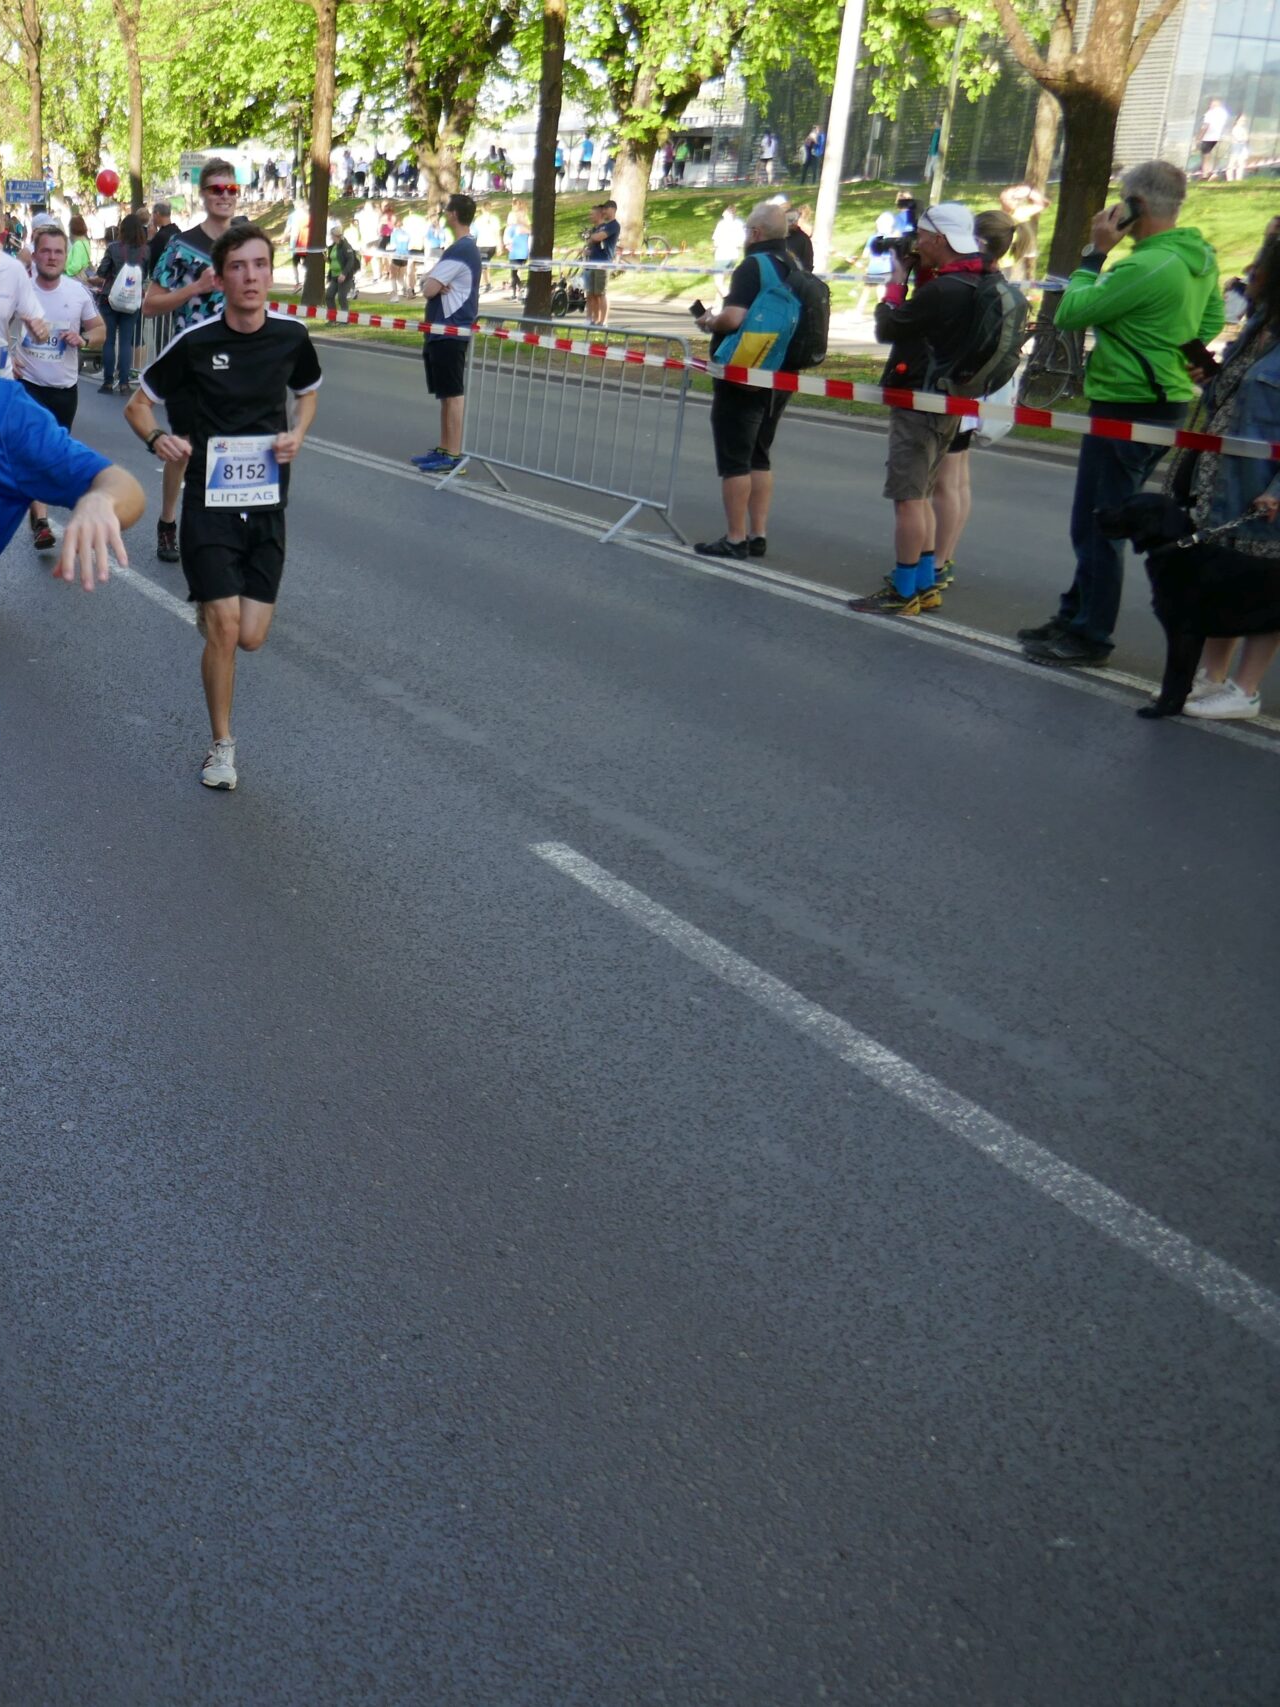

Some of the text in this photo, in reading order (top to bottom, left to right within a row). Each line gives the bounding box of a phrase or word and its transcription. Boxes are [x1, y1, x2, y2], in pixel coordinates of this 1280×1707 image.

[223, 463, 266, 480] 8152
[211, 491, 274, 503] LINZ AG
